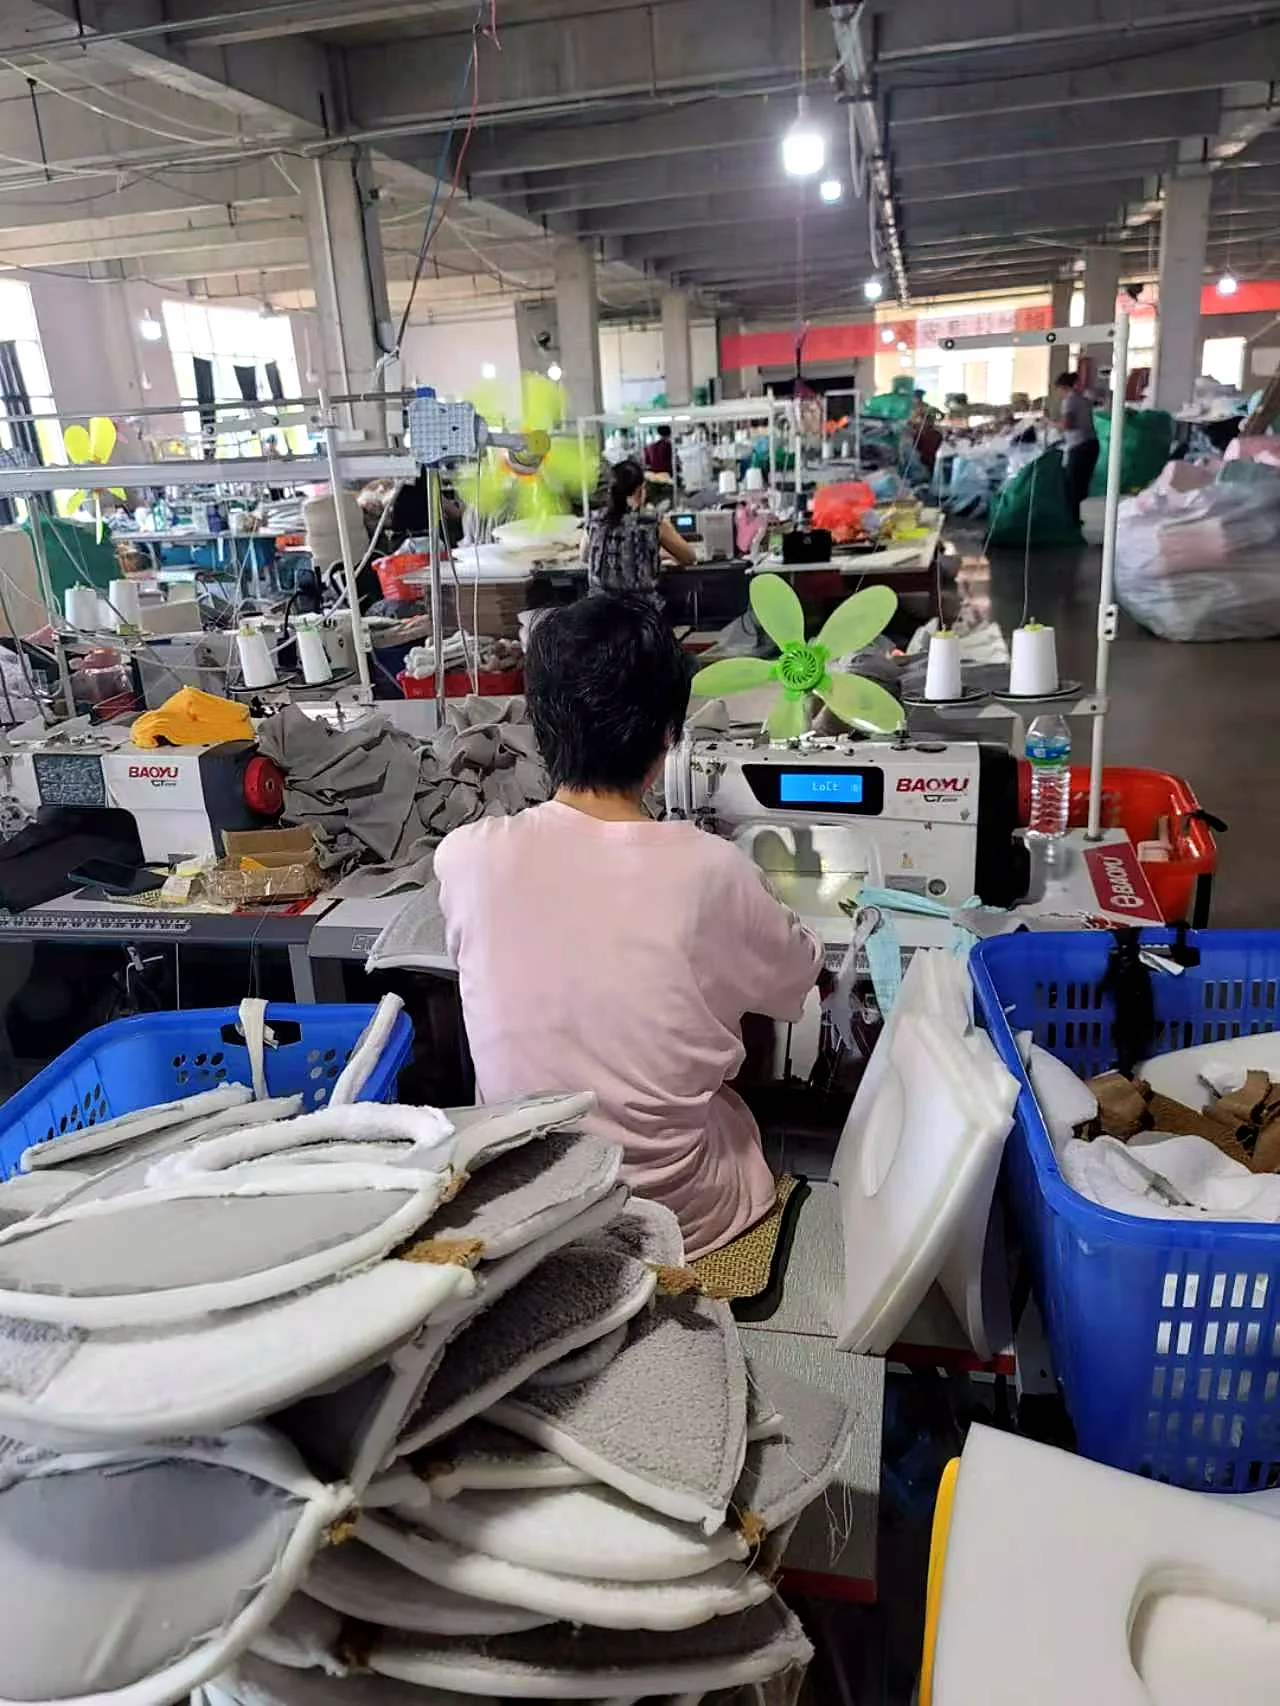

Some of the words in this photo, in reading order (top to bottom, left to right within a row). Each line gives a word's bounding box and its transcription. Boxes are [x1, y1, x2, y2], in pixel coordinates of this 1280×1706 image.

[129, 766, 178, 778] BAOYU
[896, 778, 969, 792] BAOYU
[1103, 856, 1135, 894] BAOYU
